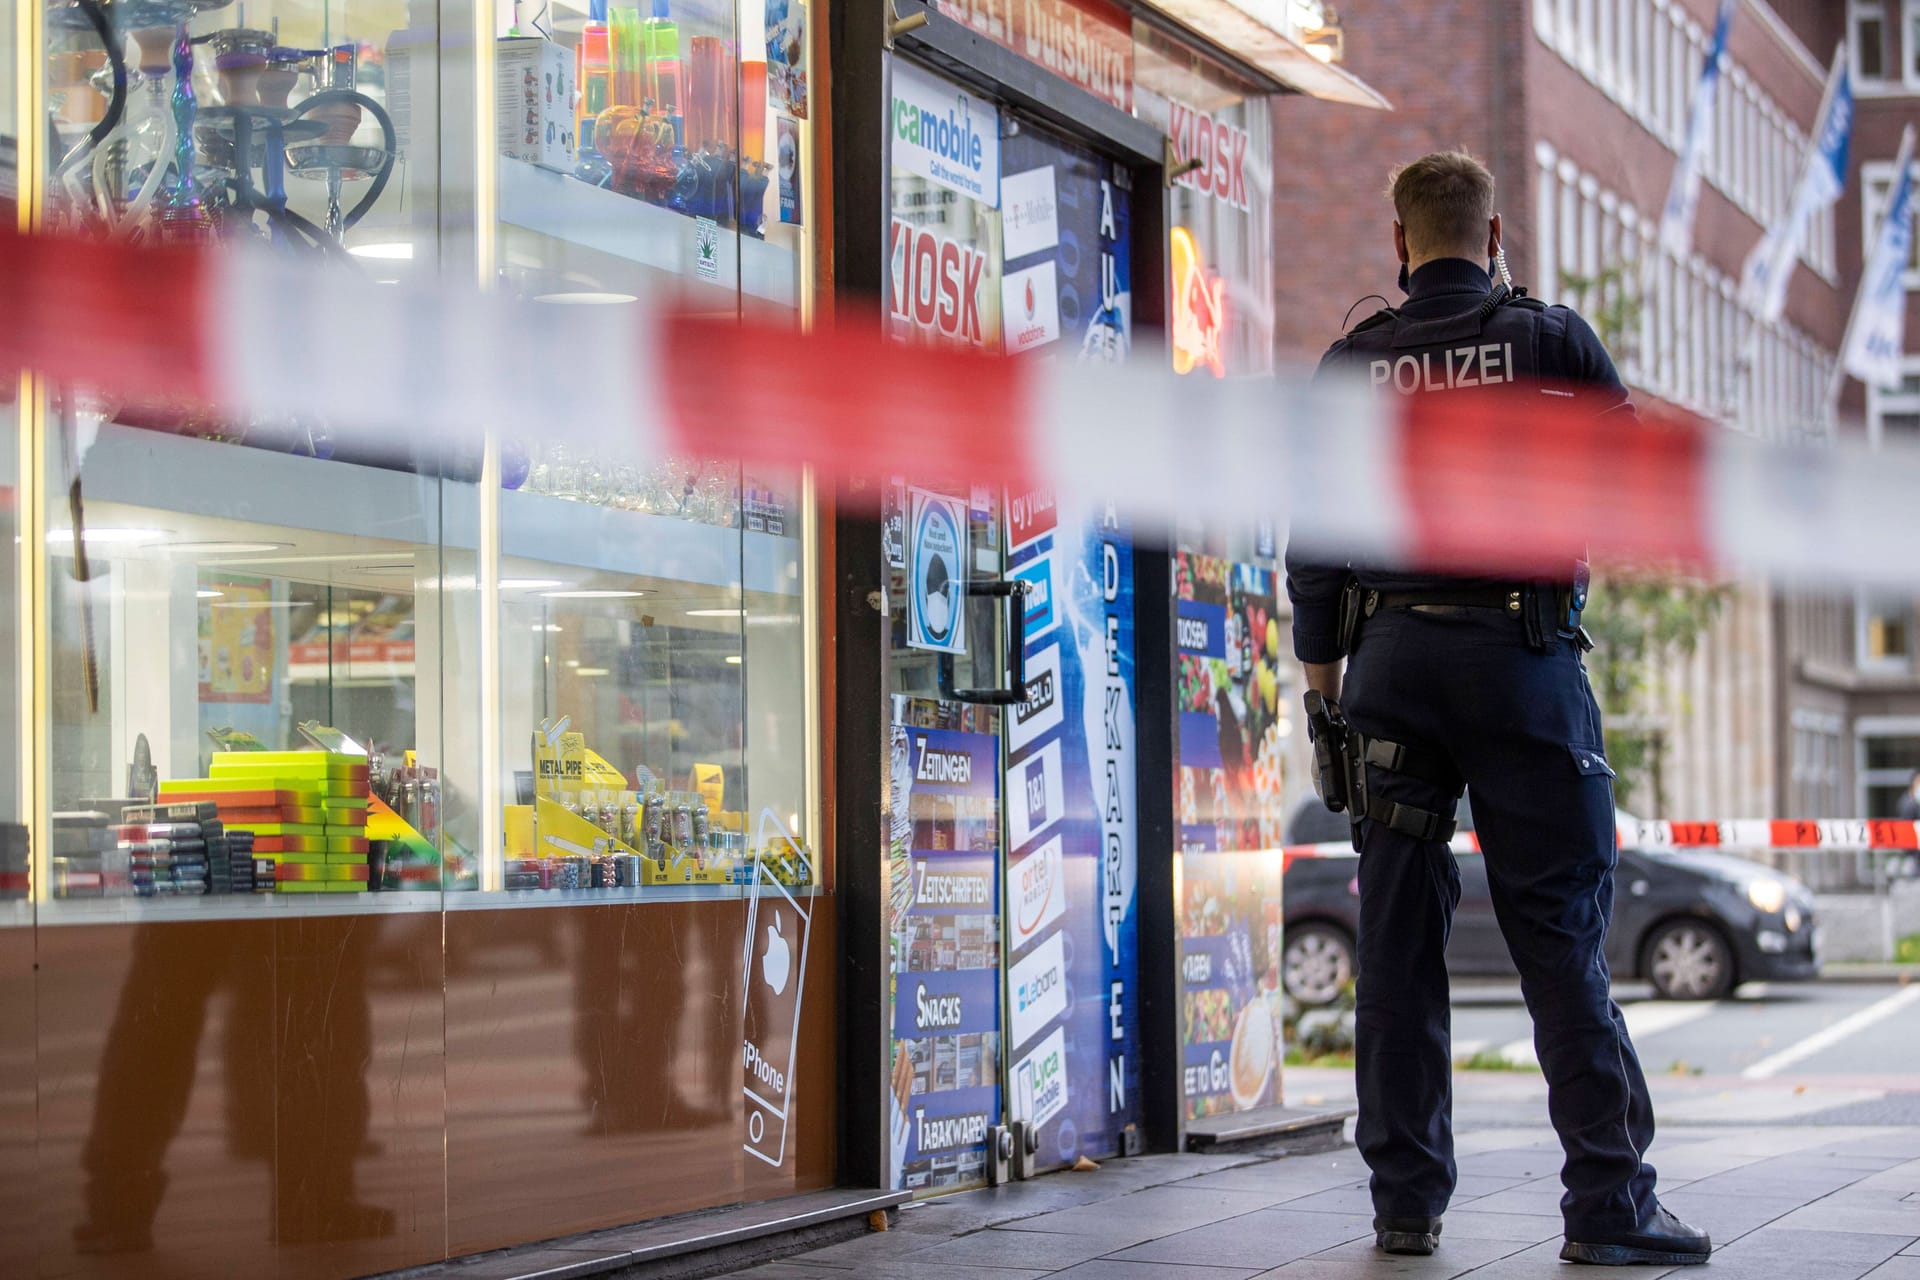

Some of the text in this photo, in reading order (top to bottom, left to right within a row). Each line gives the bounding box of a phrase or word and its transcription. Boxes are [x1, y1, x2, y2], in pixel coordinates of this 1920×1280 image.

[1025, 0, 1125, 112] Duisburg
[1370, 342, 1514, 395] POLIZEI
[540, 760, 563, 775] METAL
[566, 760, 582, 775] PIPE
[1028, 773, 1044, 814] 1&1
[1023, 850, 1046, 892] ortel
[1026, 966, 1057, 1006] Lebara
[744, 1039, 784, 1093] iPhone
[1032, 1050, 1059, 1092] Lyca
